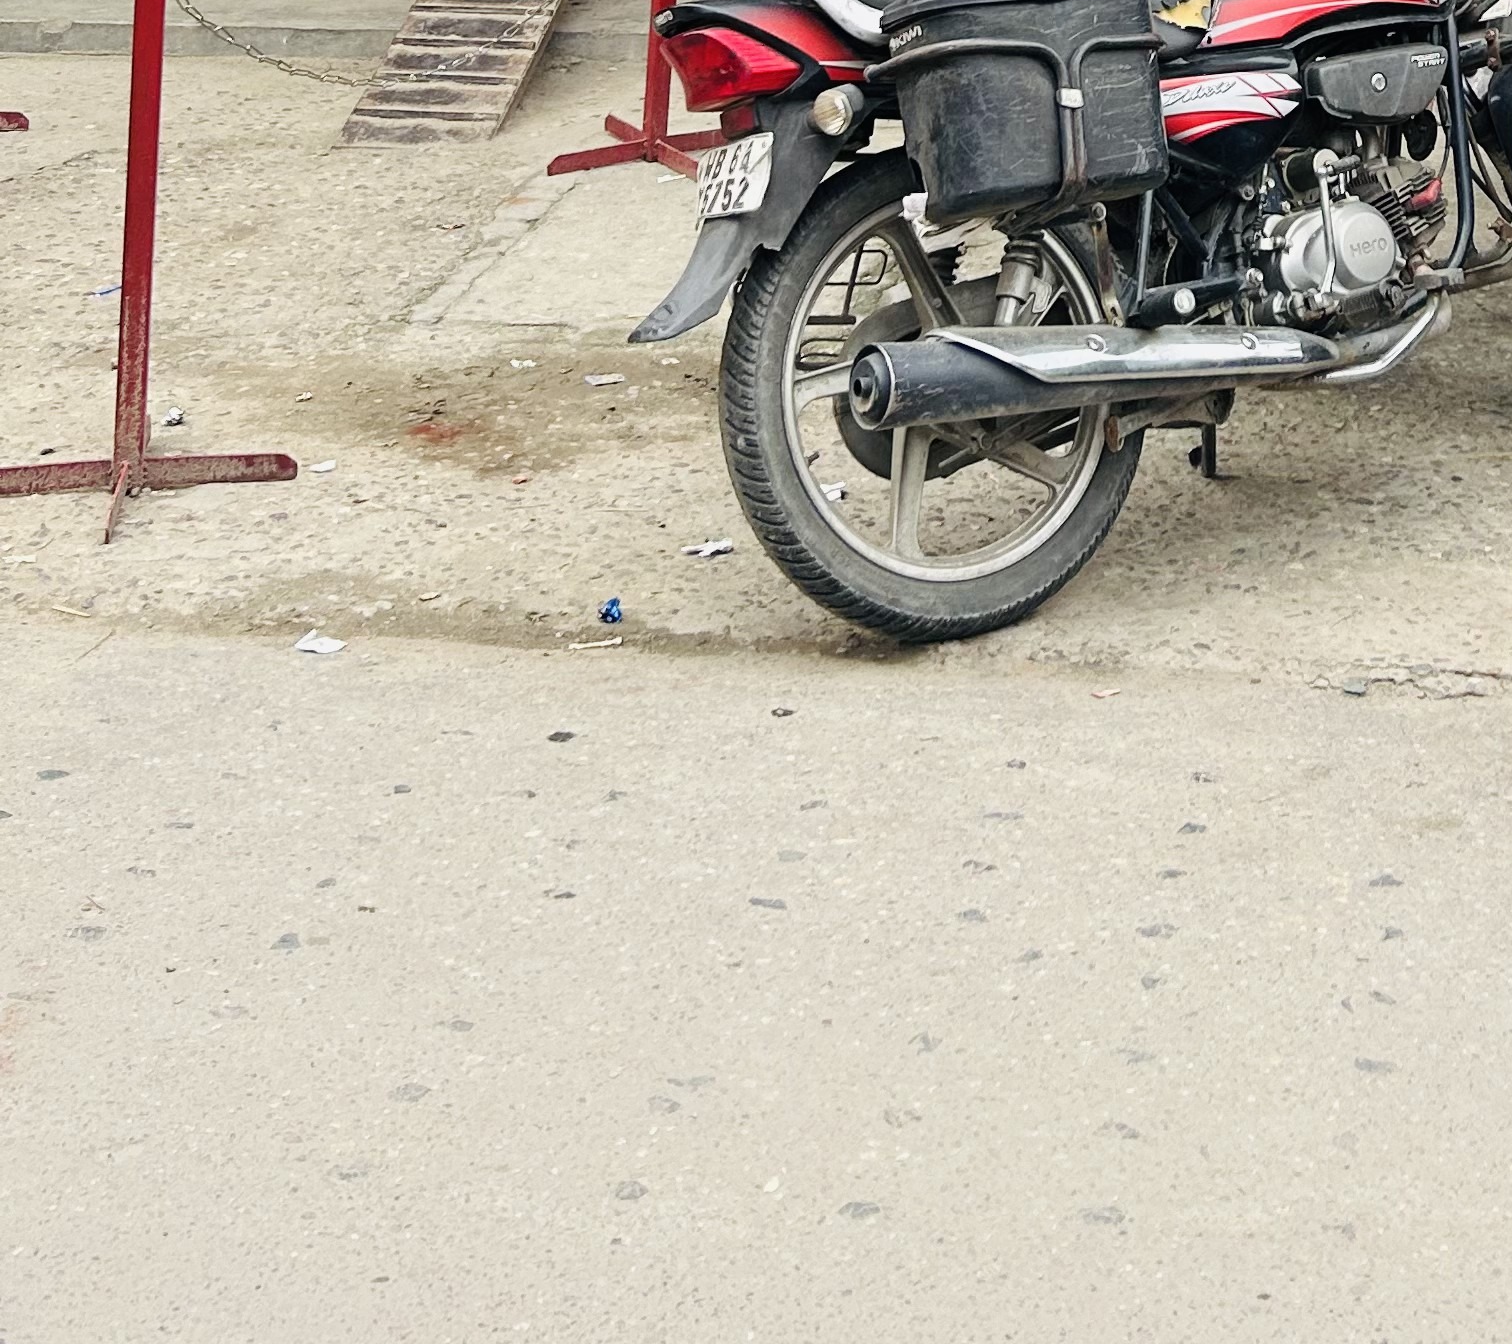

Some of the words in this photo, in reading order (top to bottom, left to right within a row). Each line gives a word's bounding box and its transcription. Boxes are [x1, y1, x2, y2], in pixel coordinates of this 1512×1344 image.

[895, 24, 923, 47] KIWI
[699, 148, 727, 182] WB
[729, 140, 755, 175] 64
